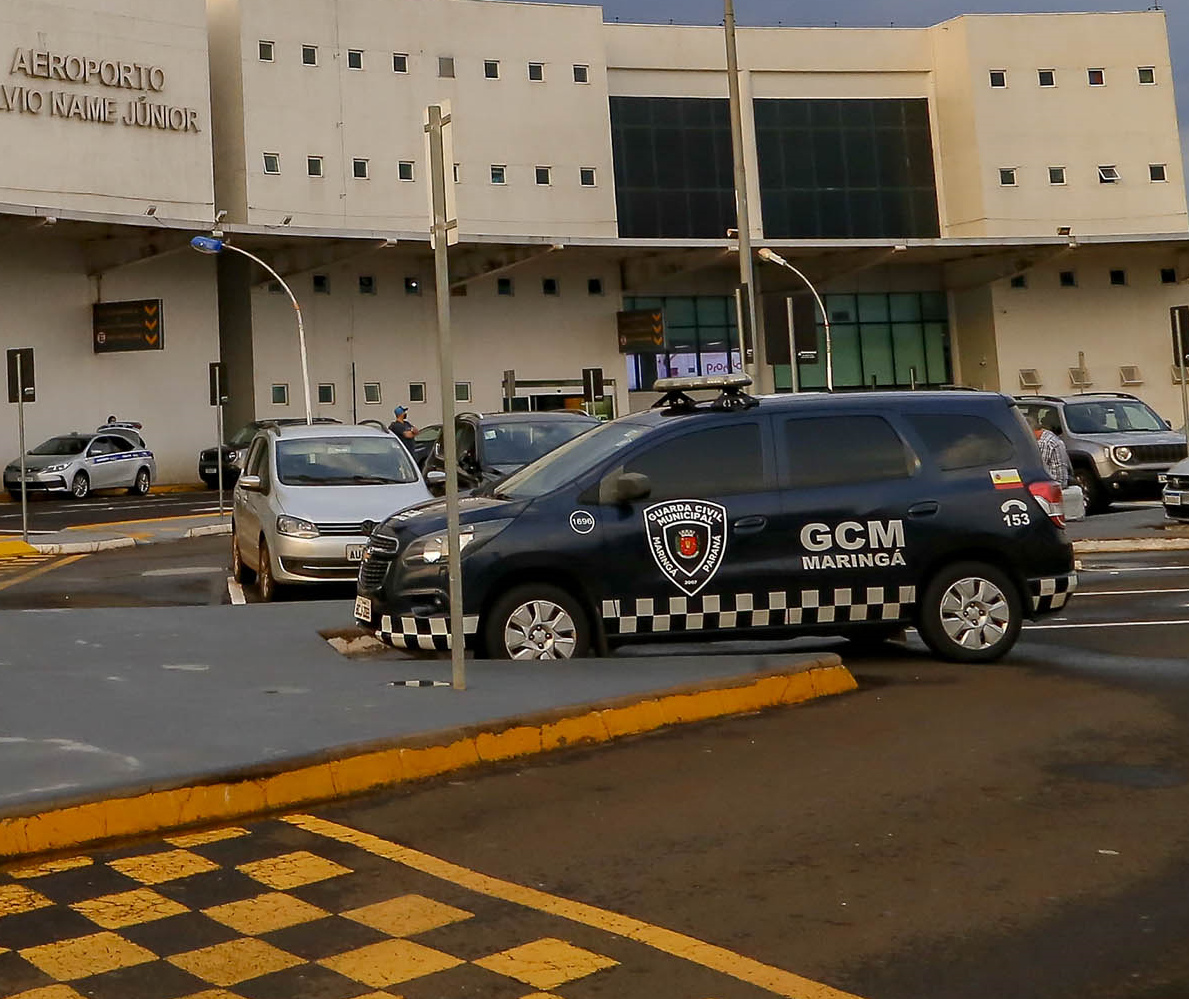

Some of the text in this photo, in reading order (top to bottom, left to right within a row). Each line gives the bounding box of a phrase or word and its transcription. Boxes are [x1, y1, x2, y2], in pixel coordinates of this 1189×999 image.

[11, 48, 166, 93] AEROPORTO
[51, 91, 118, 123] NAME
[122, 95, 201, 133] JÚNIOR
[648, 504, 723, 522] GUARDA CIVIL
[657, 512, 713, 527] MUNICIPAL
[1003, 513, 1031, 527] 153
[800, 520, 906, 552] GCM
[652, 536, 679, 577] MARINGÁ
[702, 535, 722, 573] PARANÁ
[802, 549, 906, 570] MARINGÁ
